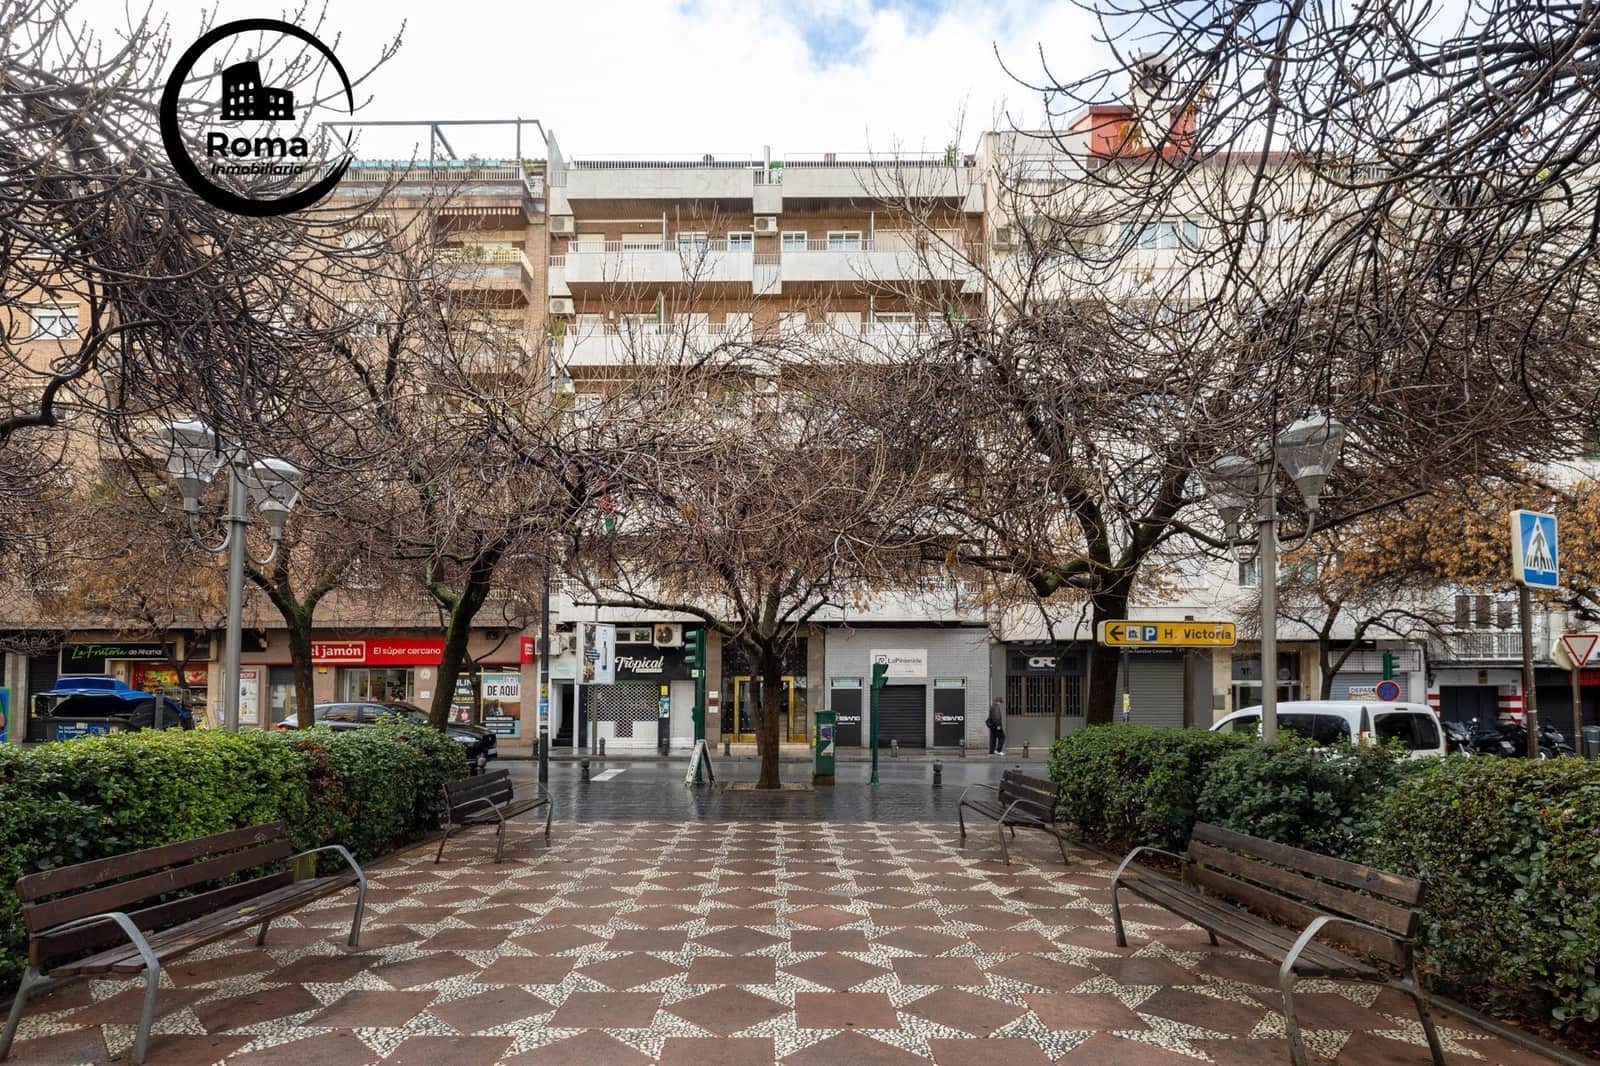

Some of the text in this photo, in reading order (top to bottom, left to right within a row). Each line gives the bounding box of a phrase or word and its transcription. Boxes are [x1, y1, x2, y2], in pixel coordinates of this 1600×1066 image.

[1164, 629, 1178, 639] H.
[1183, 629, 1232, 640] Victoria
[321, 643, 361, 658] jamón
[373, 645, 441, 657] El súper cercano
[614, 655, 664, 673] Tropical
[487, 685, 498, 696] DE
